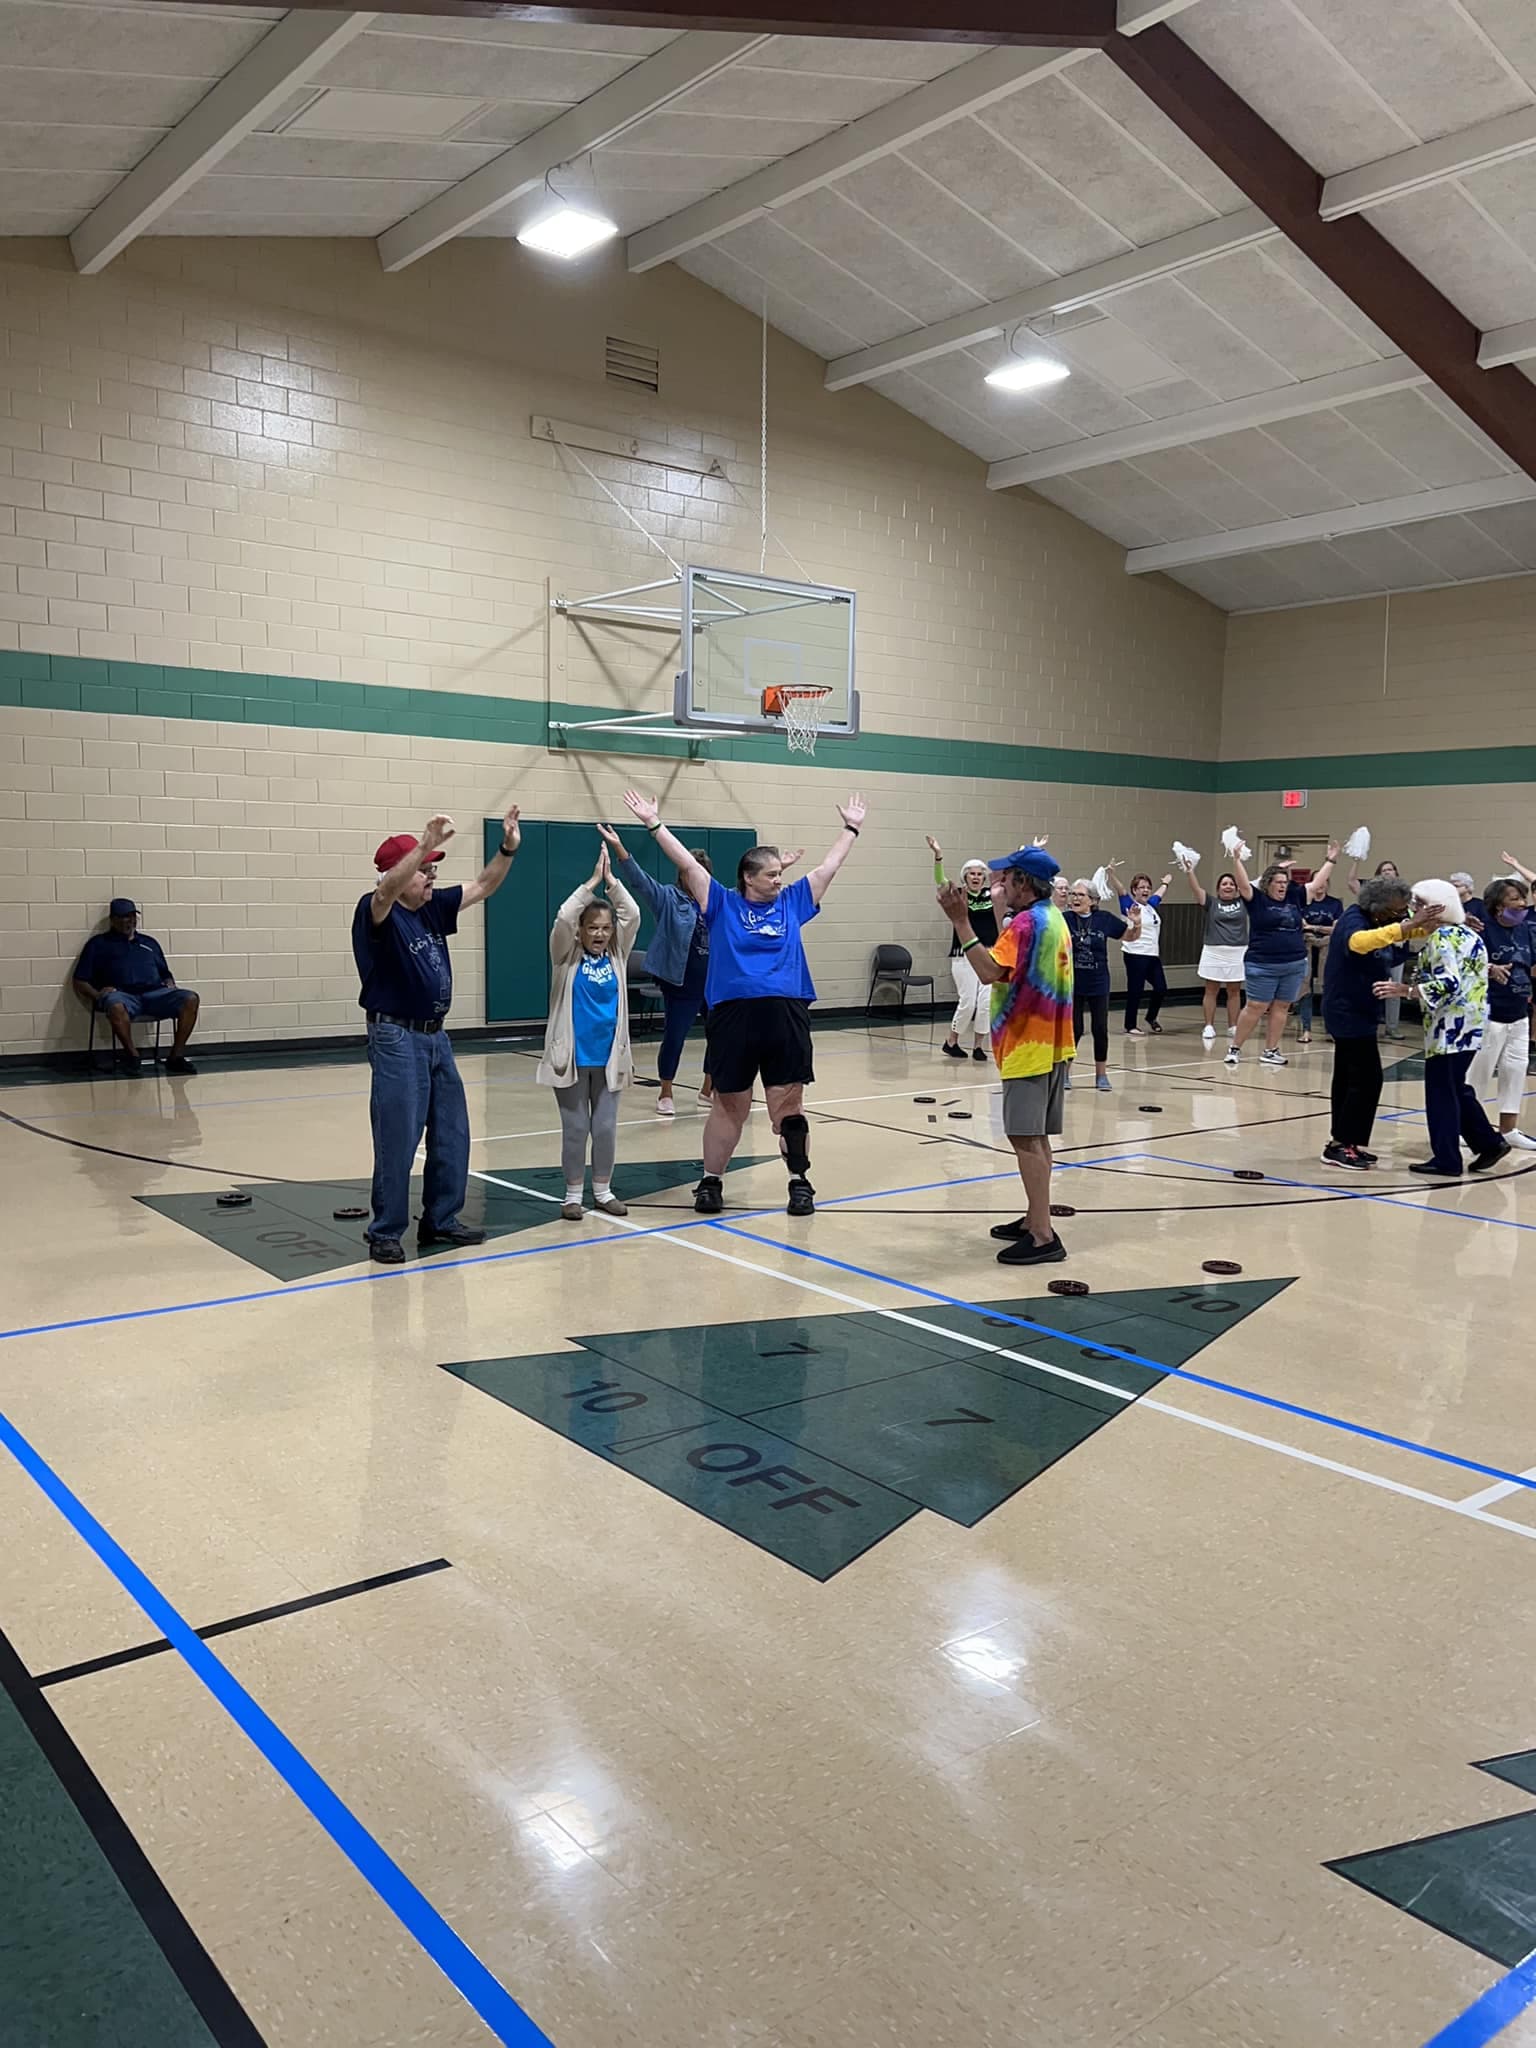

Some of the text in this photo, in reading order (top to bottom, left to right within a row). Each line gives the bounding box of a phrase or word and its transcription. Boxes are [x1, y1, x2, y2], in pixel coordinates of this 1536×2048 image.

[256, 1231, 347, 1258] OFF
[1168, 1292, 1240, 1313] 10
[562, 1380, 648, 1413] 10
[924, 1407, 995, 1426] 7
[686, 1443, 863, 1515] OFF
